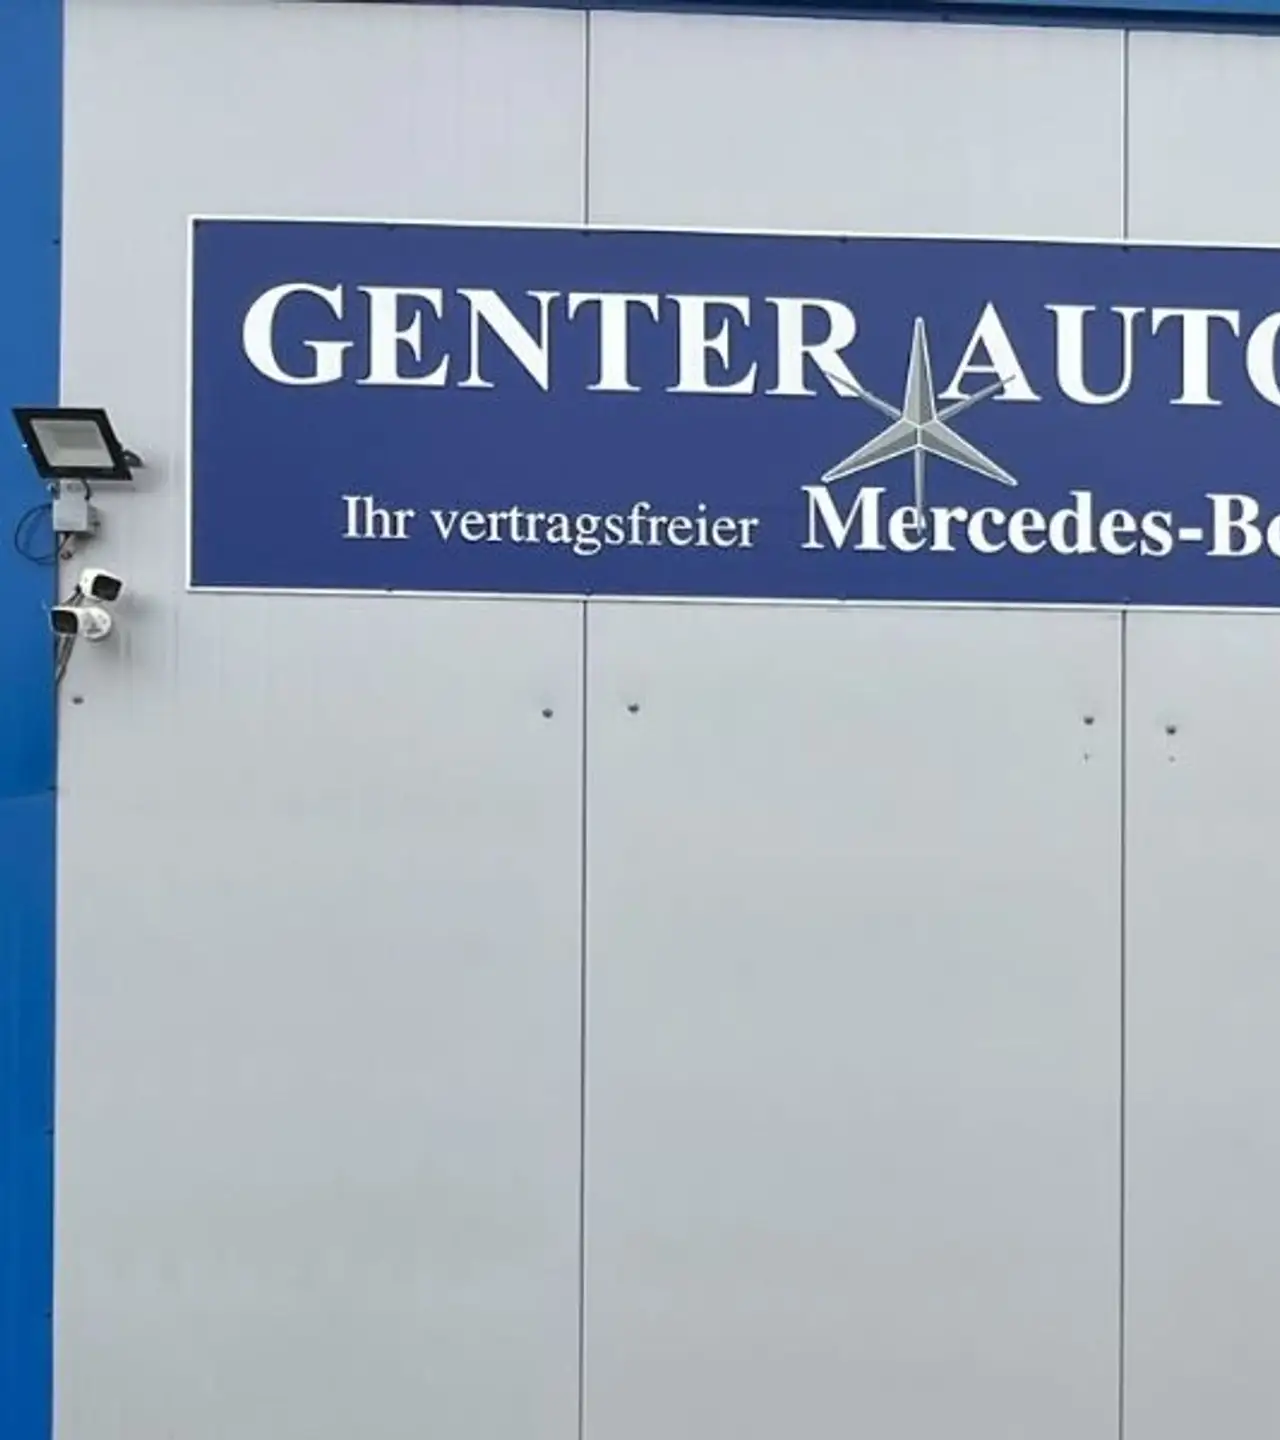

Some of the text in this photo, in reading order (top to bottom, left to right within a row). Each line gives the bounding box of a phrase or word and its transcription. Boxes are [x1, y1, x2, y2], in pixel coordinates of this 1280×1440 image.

[243, 283, 859, 398] GENTER
[342, 495, 414, 539] Ihr
[430, 501, 759, 556] vertragsfreier
